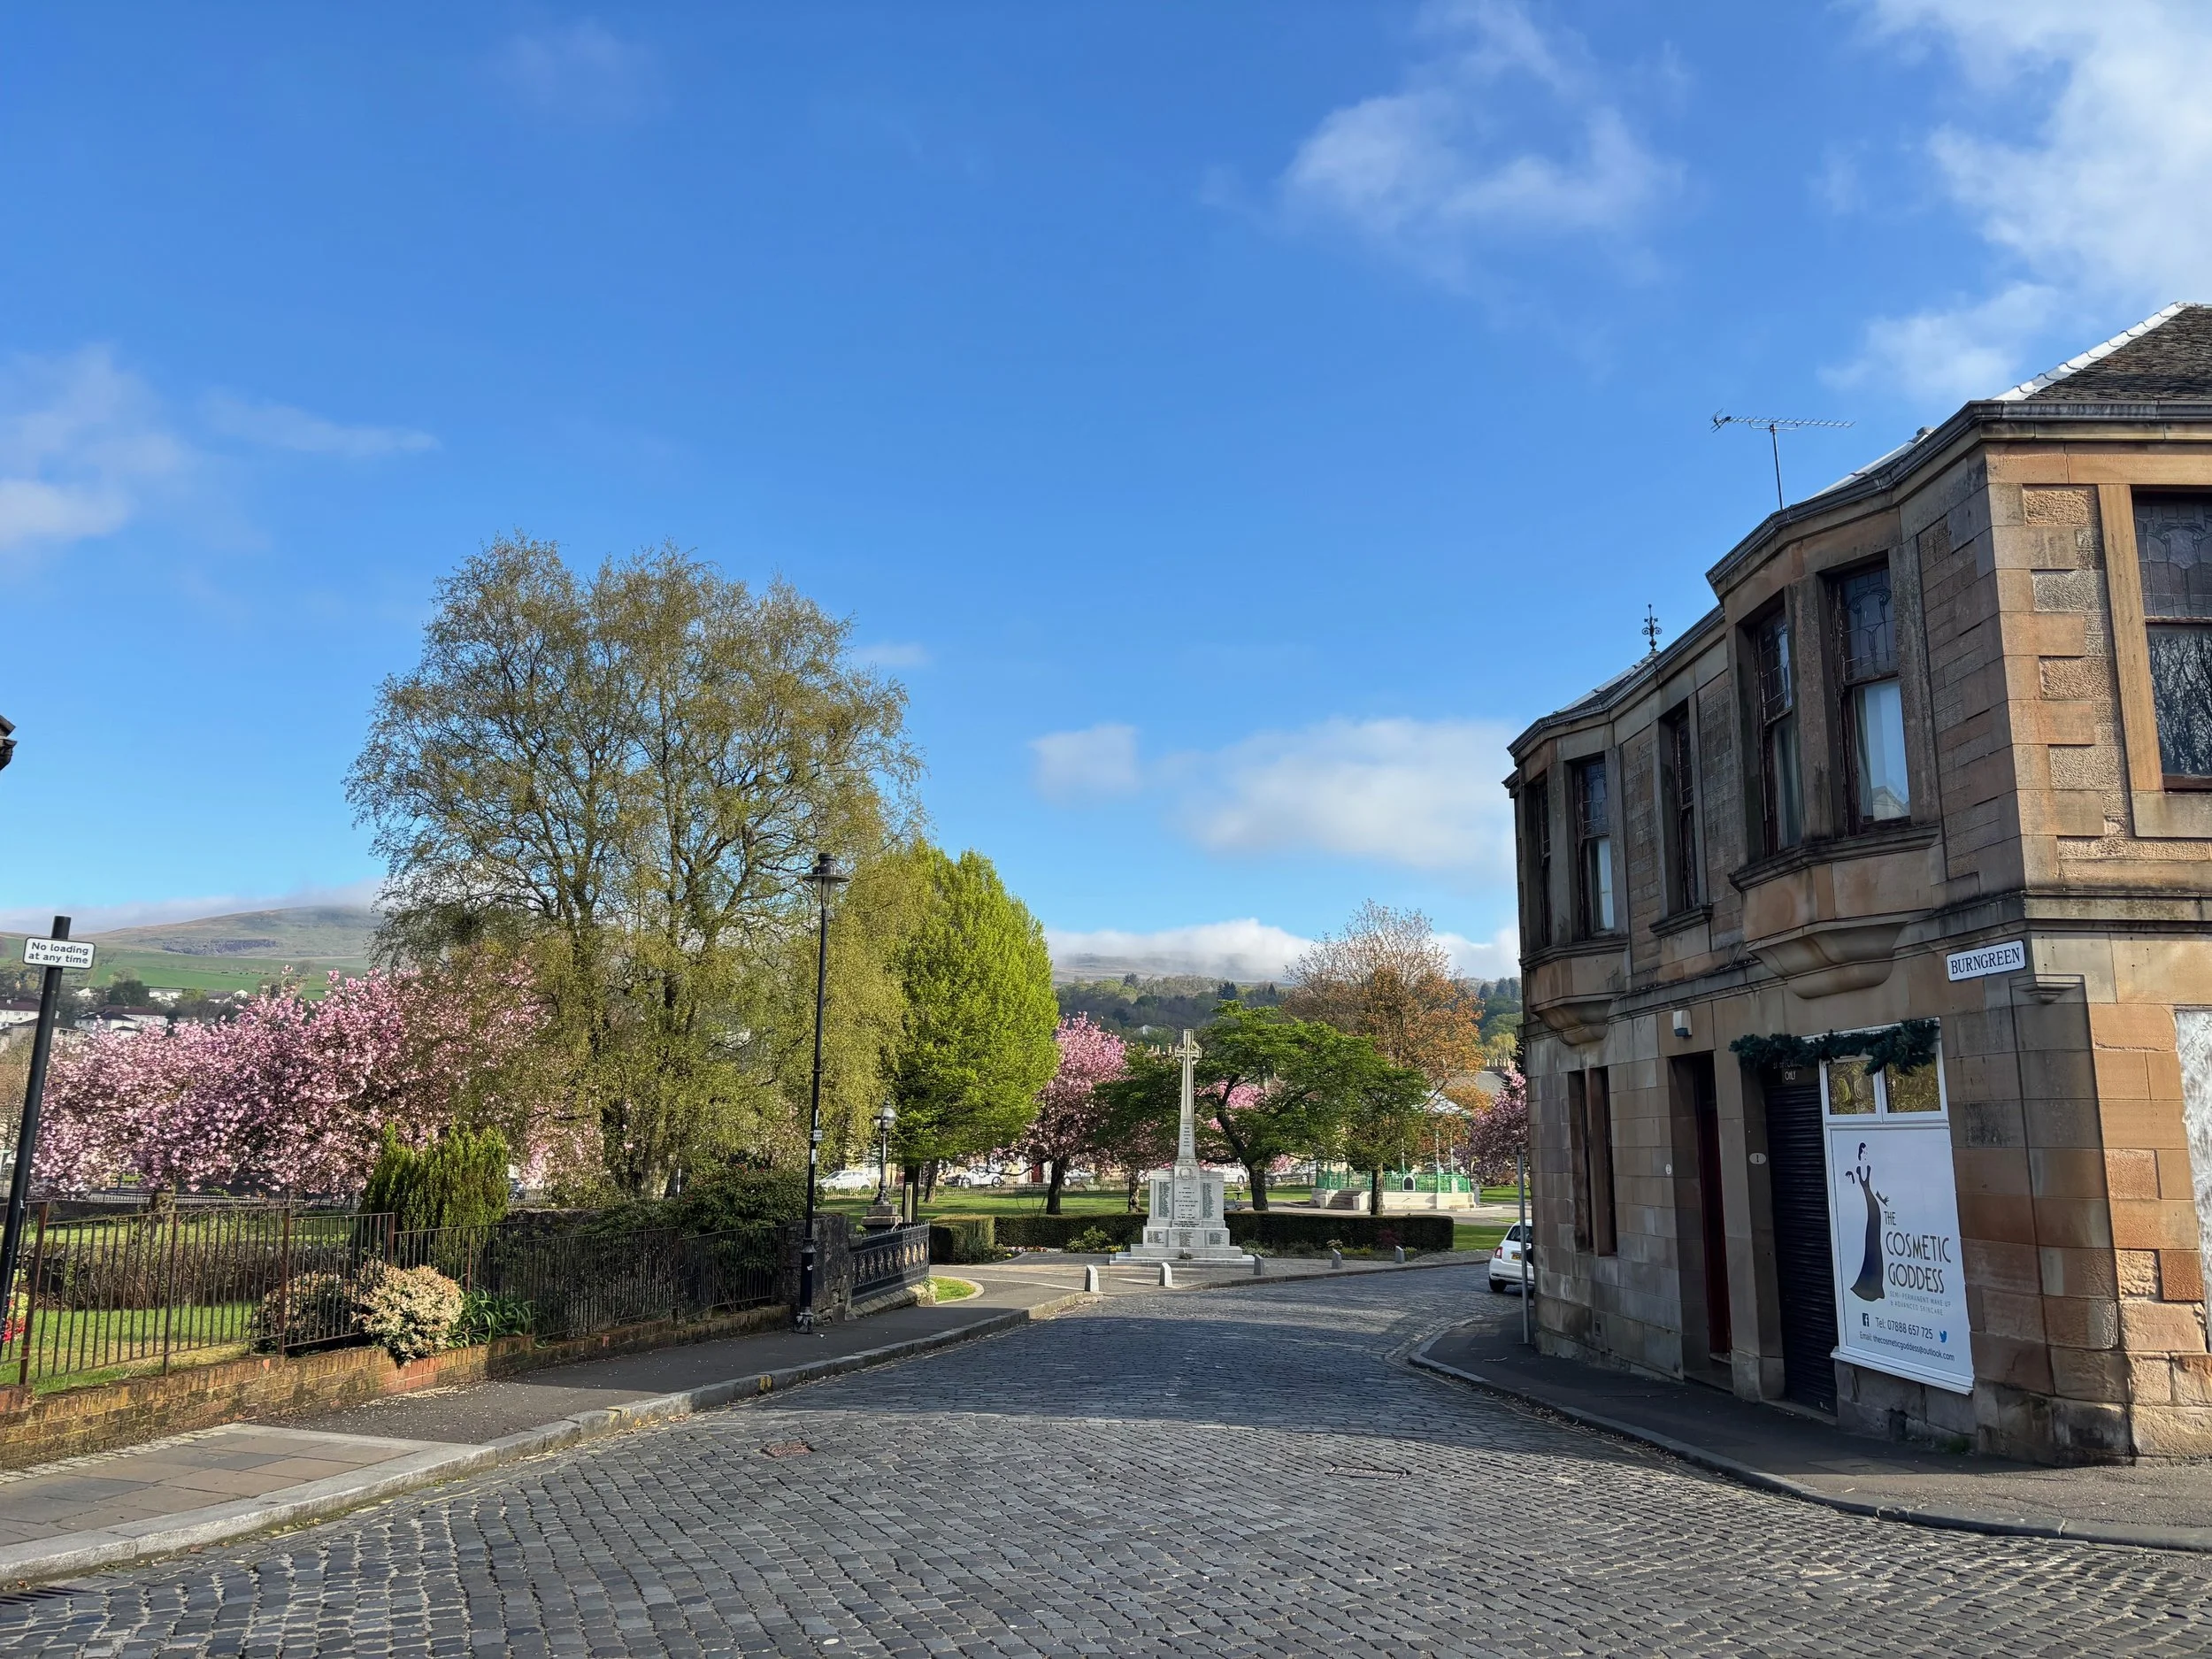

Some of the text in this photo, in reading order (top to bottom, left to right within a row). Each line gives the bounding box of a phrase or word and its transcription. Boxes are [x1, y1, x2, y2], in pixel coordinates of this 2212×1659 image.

[31, 941, 89, 956] No loading
[42, 954, 62, 963] any
[65, 955, 88, 964] time
[1950, 947, 2021, 974] BURNGREEN
[1884, 1210, 1897, 1225] THE
[1886, 1231, 1952, 1263] COSMETIC
[1887, 1262, 1945, 1294] GODDESS
[1894, 1301, 1919, 1311] ADVANCED
[1920, 1305, 1944, 1317] SKINCARE
[1859, 1331, 1872, 1340] Email:
[1875, 1317, 1933, 1340] Tel: 07888 657 725
